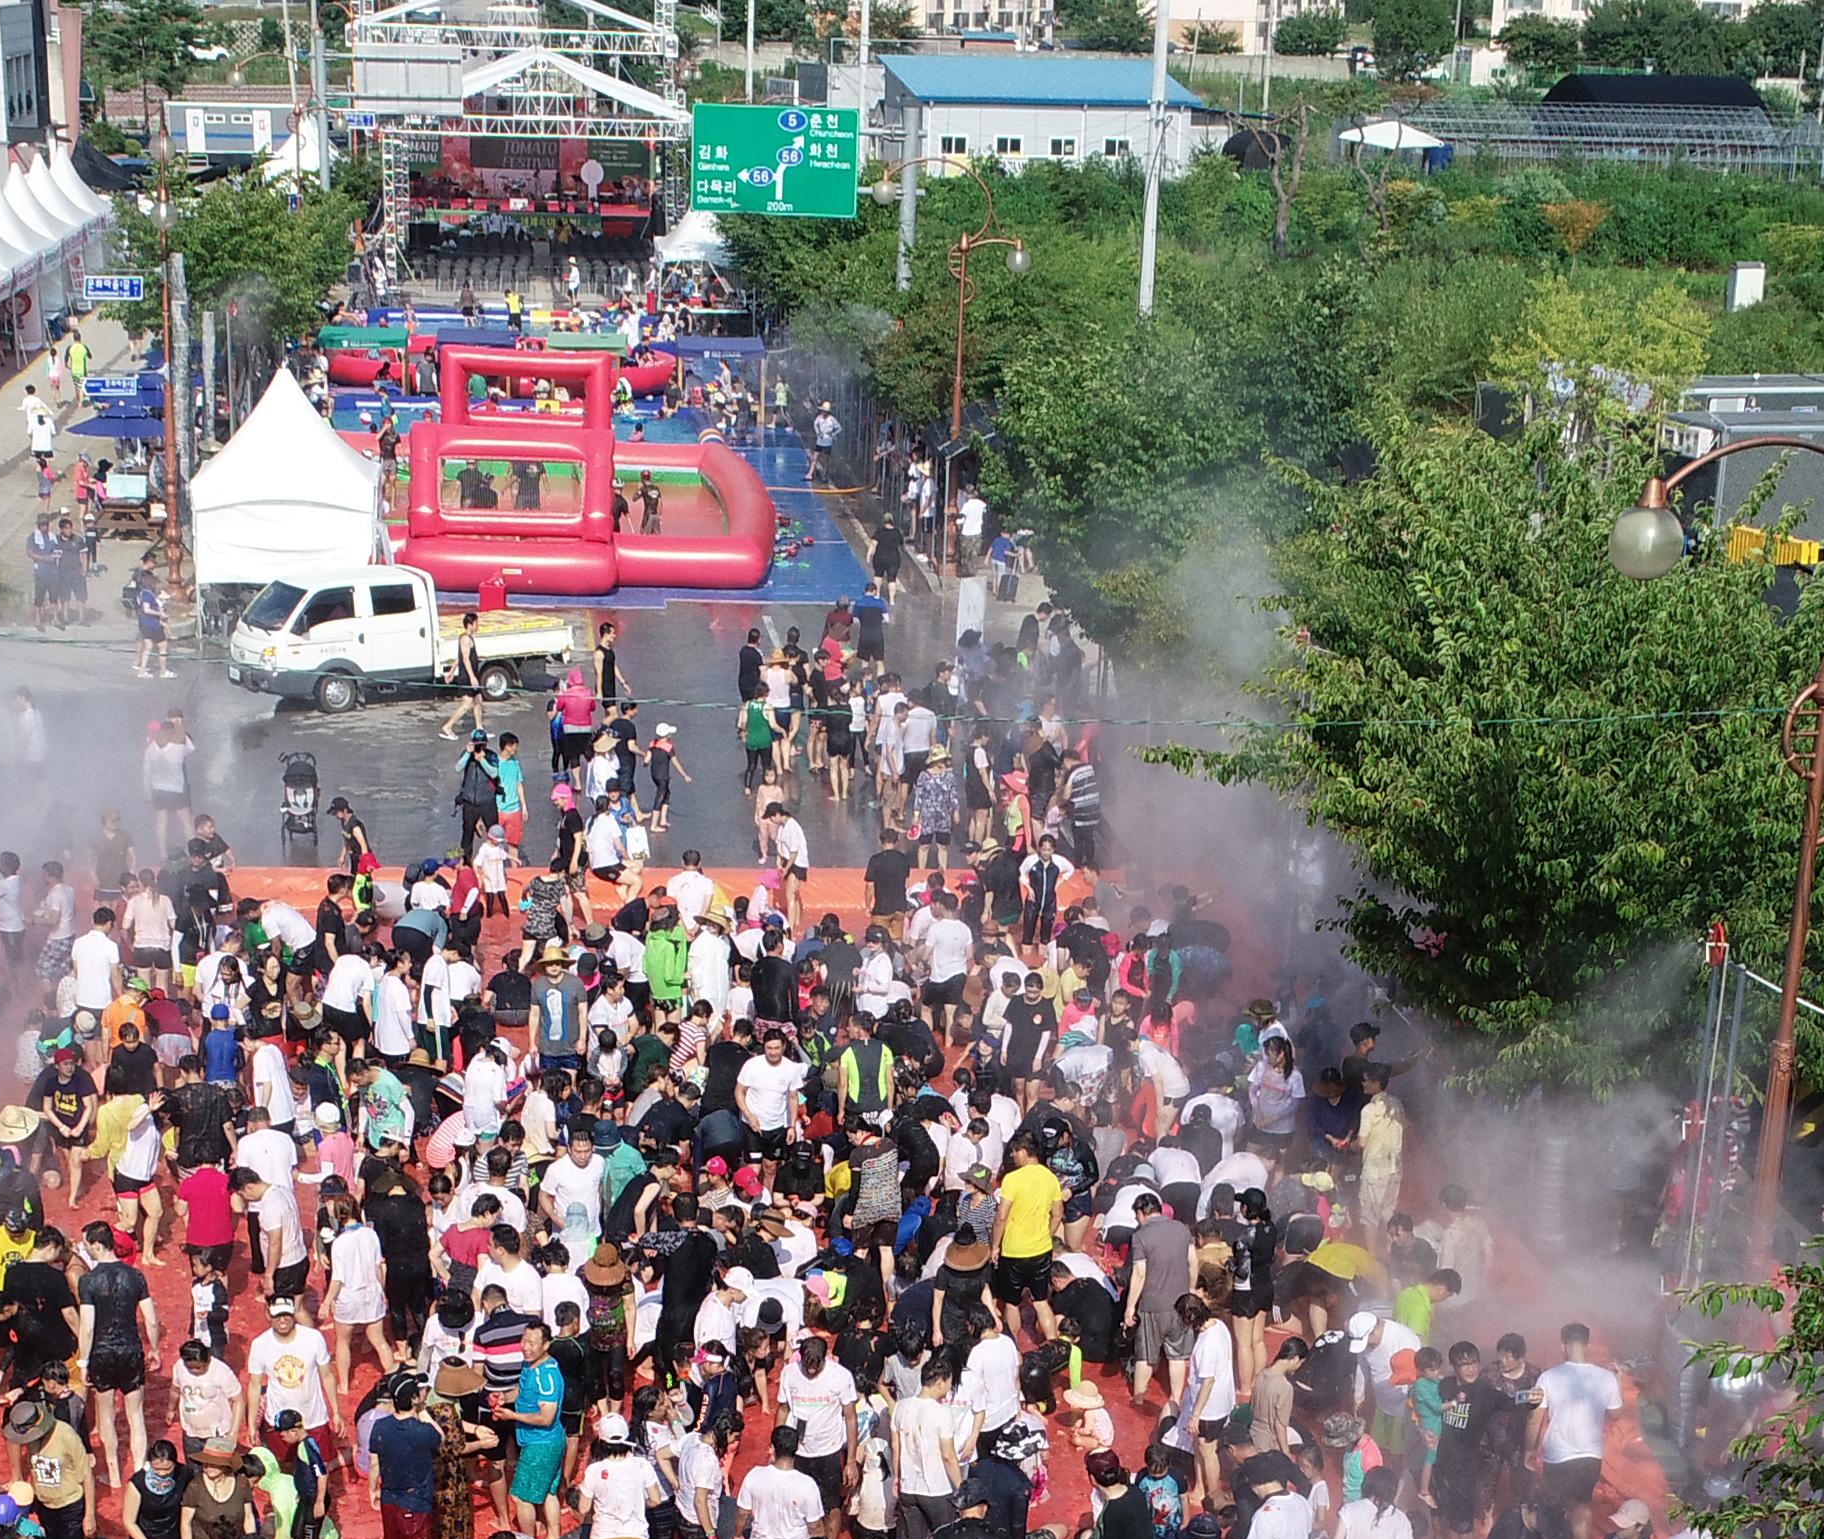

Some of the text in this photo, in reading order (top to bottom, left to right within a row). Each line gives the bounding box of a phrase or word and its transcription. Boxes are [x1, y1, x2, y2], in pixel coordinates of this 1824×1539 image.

[788, 114, 797, 127] 5
[503, 141, 558, 155] TOMATO
[782, 150, 798, 162] 56
[753, 170, 768, 182] 56
[697, 179, 736, 195] 다목리
[767, 201, 793, 212] 200m
